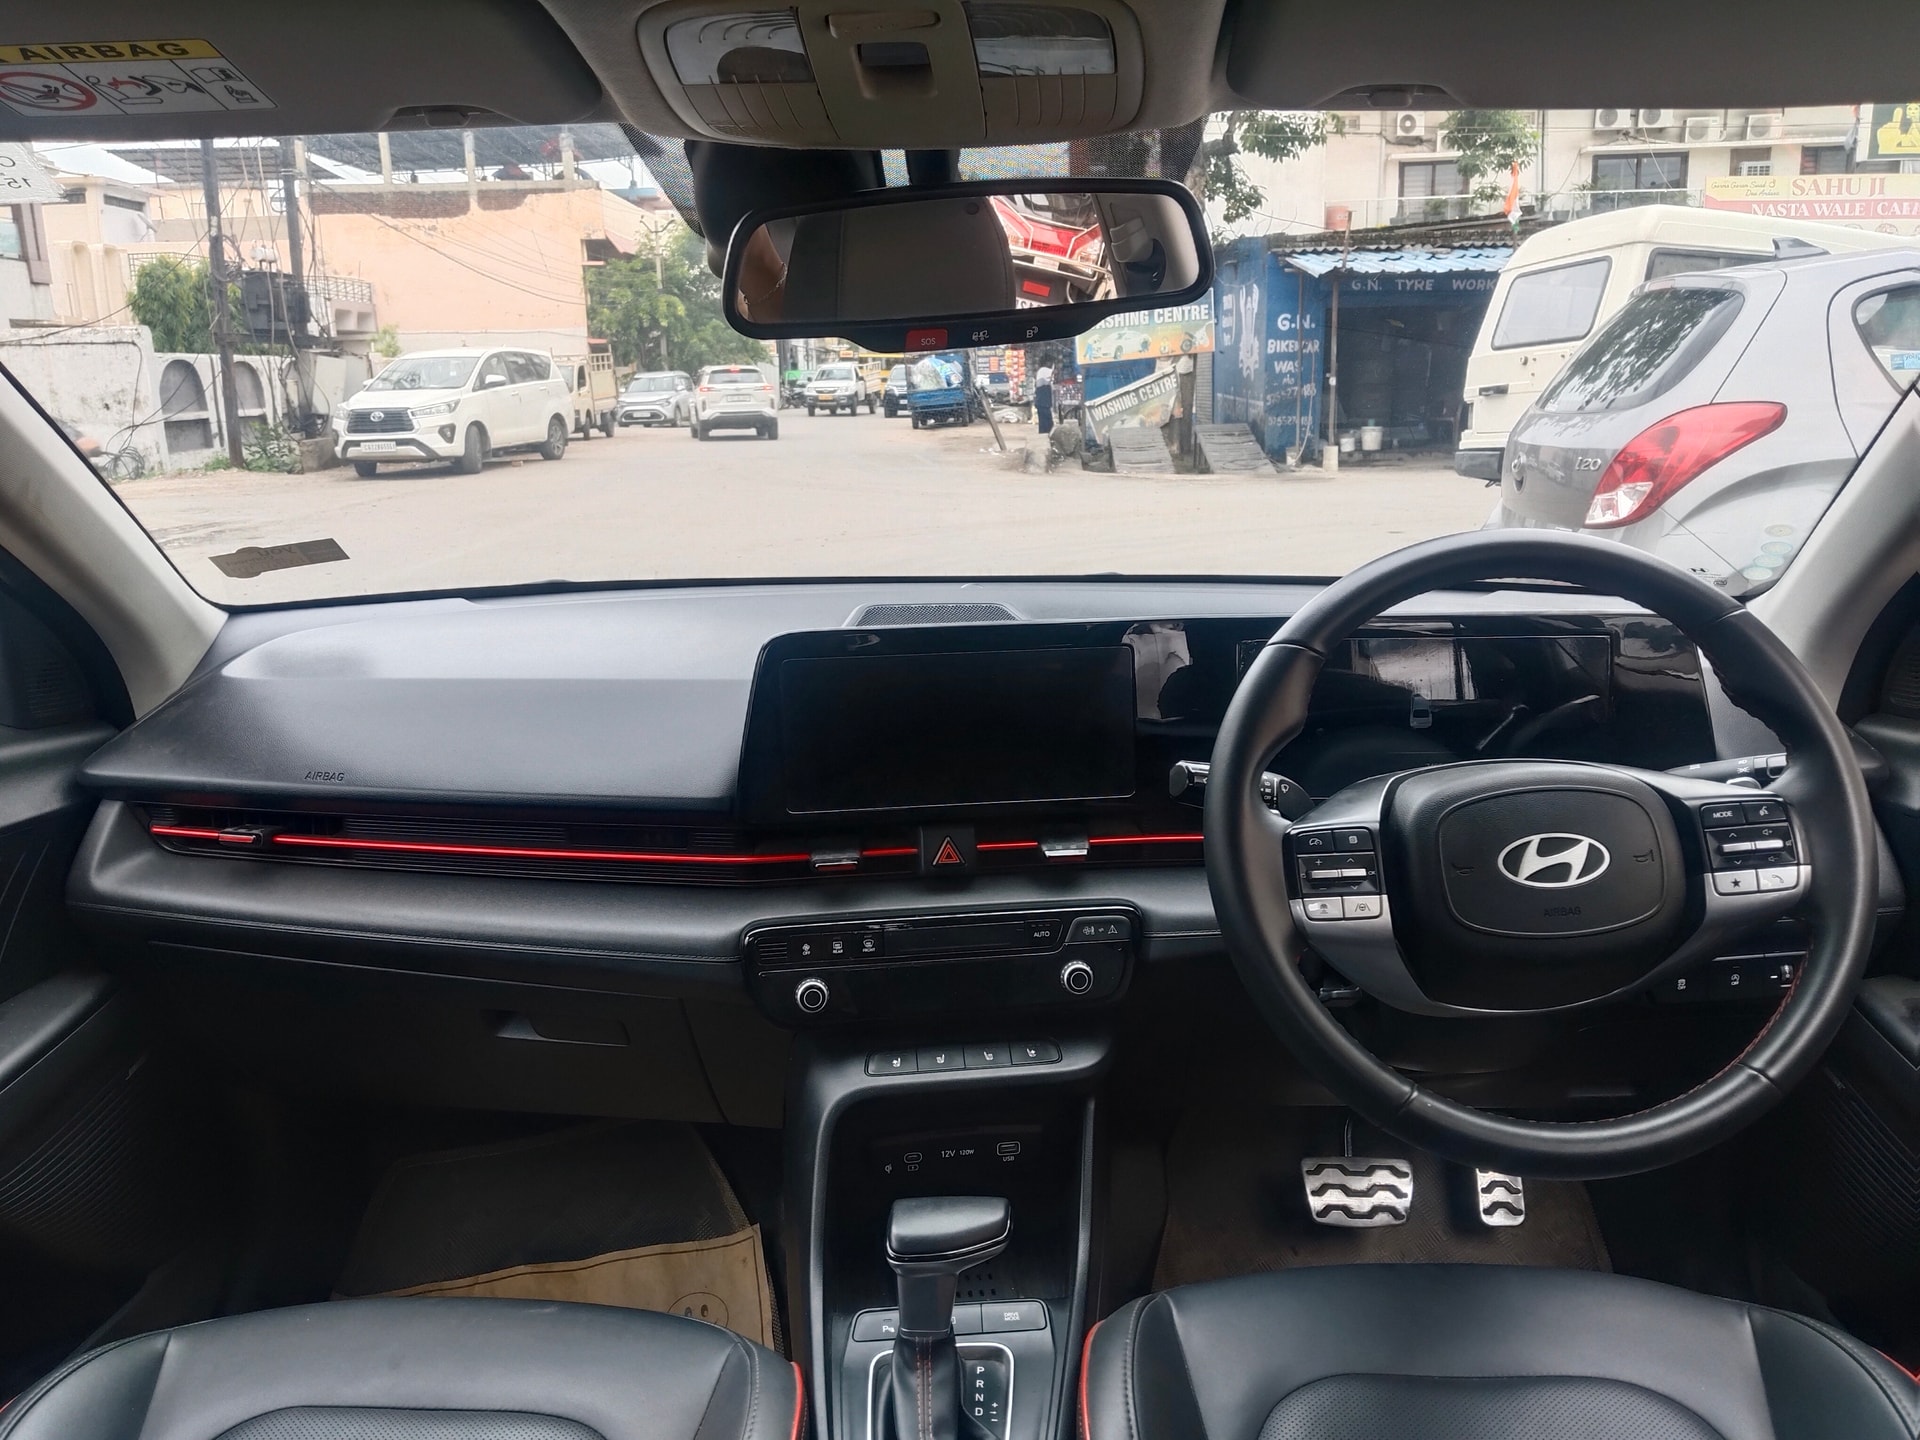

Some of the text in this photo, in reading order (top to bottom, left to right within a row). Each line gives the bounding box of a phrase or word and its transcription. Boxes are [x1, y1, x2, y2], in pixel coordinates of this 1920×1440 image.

[18, 42, 190, 61] AIRBAG
[1792, 177, 1862, 197] SAHU
[1869, 177, 1886, 197] JI
[1751, 203, 1810, 217] NASTA
[1813, 202, 1866, 217] WALE
[1351, 279, 1497, 292] G.N. TYRE WORK
[1092, 304, 1209, 330] ASHING CENTRE
[920, 337, 936, 346] SOS
[1092, 373, 1178, 421] WASHING CENTRE
[1575, 456, 1601, 471] i20
[304, 771, 345, 781] AIRBAG
[1712, 810, 1733, 819] MODE
[1544, 906, 1582, 917] AIRBAG
[1033, 930, 1051, 938] AUTO
[941, 1149, 956, 1158] 12V
[976, 1366, 985, 1375] P
[975, 1379, 985, 1389] R
[975, 1393, 985, 1403] N
[974, 1407, 984, 1417] D
